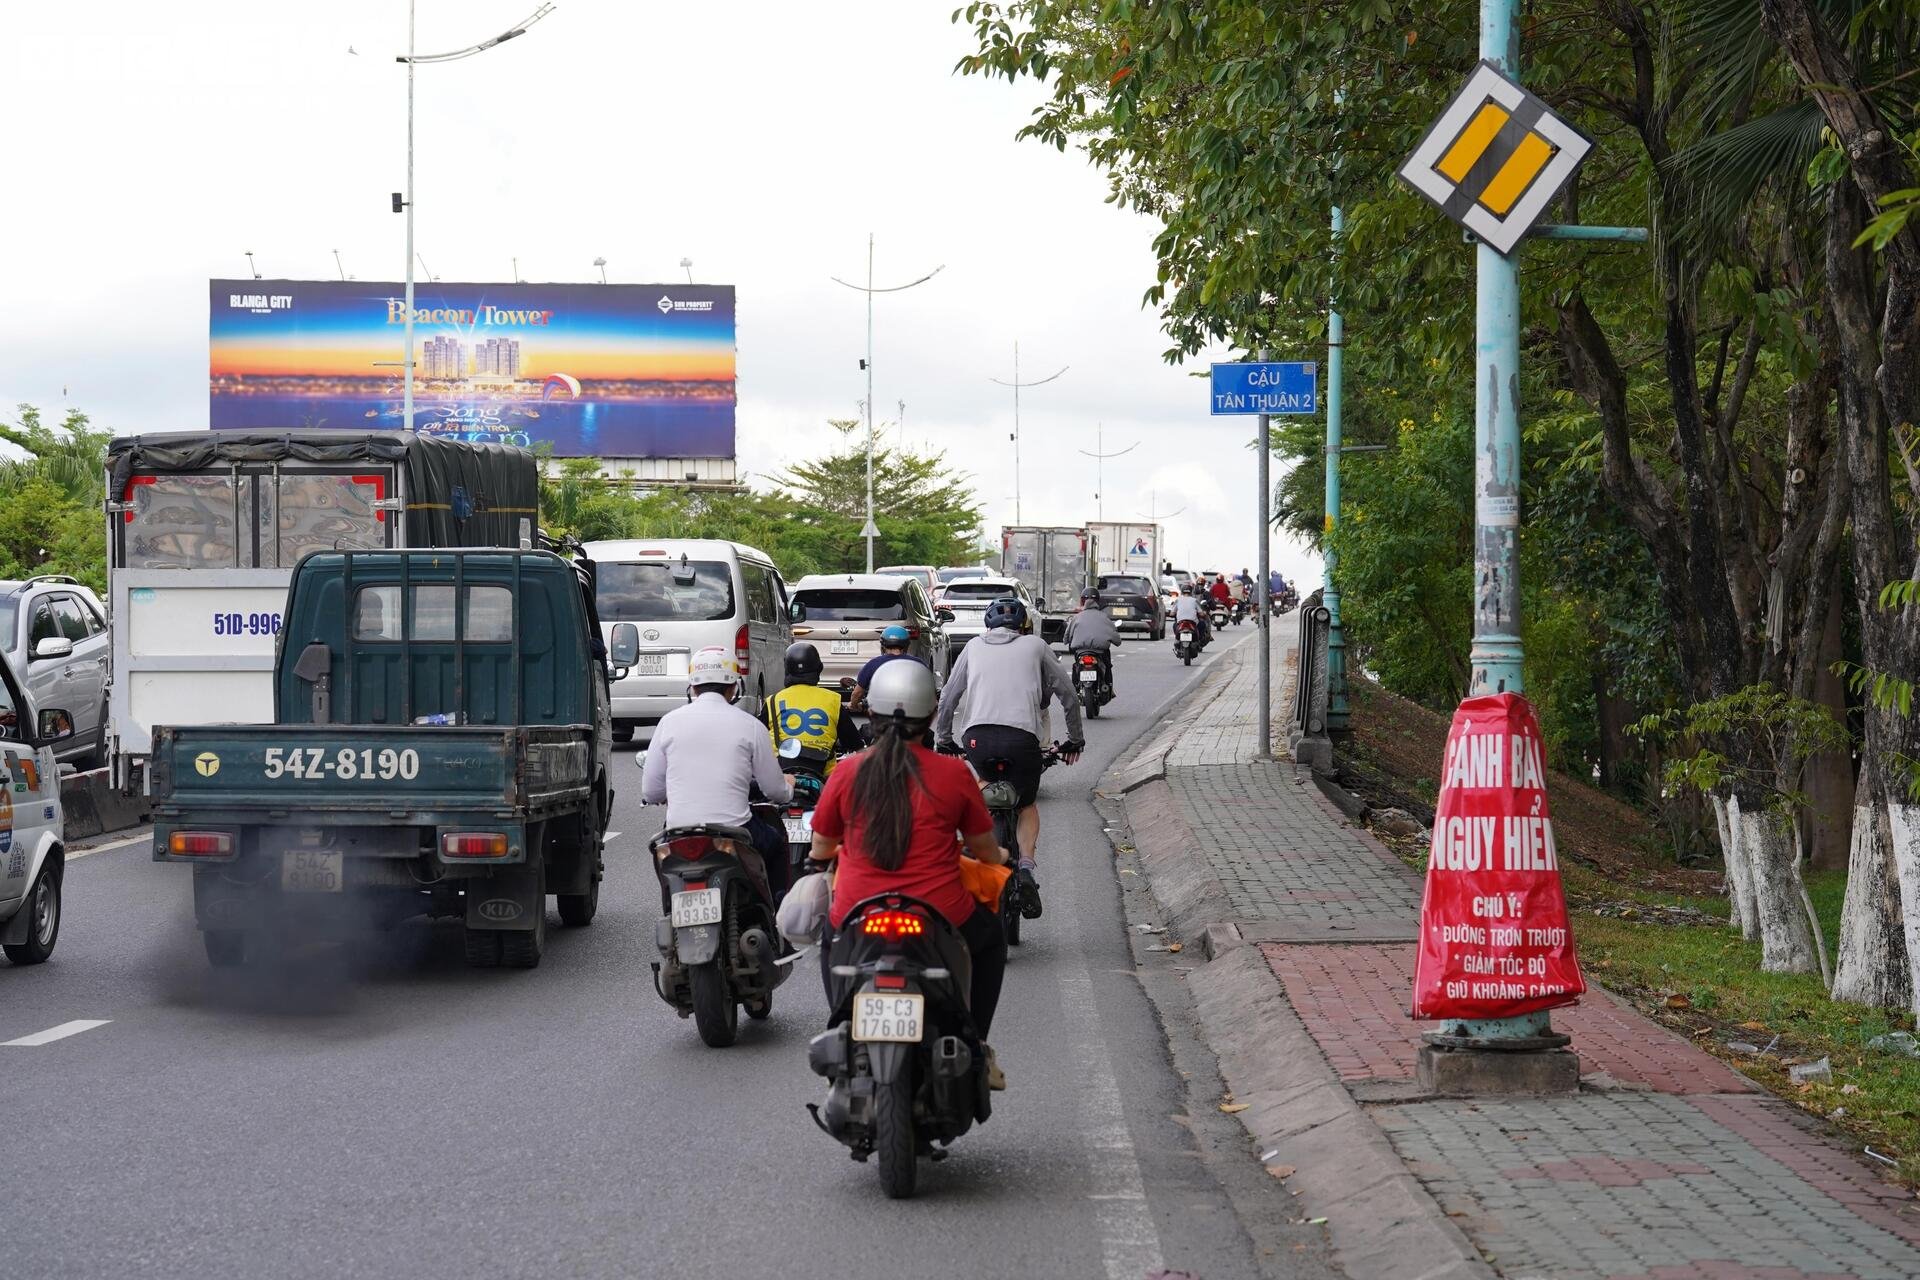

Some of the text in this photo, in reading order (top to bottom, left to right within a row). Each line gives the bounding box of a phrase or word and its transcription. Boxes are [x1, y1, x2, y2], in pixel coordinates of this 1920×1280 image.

[270, 296, 293, 308] CITY
[387, 298, 554, 326] Beacon Tower
[1215, 391, 1311, 411] TÂN THUẬN 2
[694, 662, 722, 671] HDBank
[779, 700, 829, 737] be
[264, 748, 420, 780] 54Z-8190
[1430, 816, 1497, 871] NGUY
[296, 852, 331, 870] 54Z
[486, 903, 515, 916] KIA
[676, 906, 719, 924] 193.69
[1473, 893, 1504, 918] CHÚ
[1443, 923, 1486, 945] ĐƯỜNG
[1463, 951, 1546, 978] GIẢM TỐC ĐỘ
[1447, 980, 1468, 999] GIỮ
[865, 998, 913, 1017] 59-C3
[861, 1018, 917, 1038] 176.08
